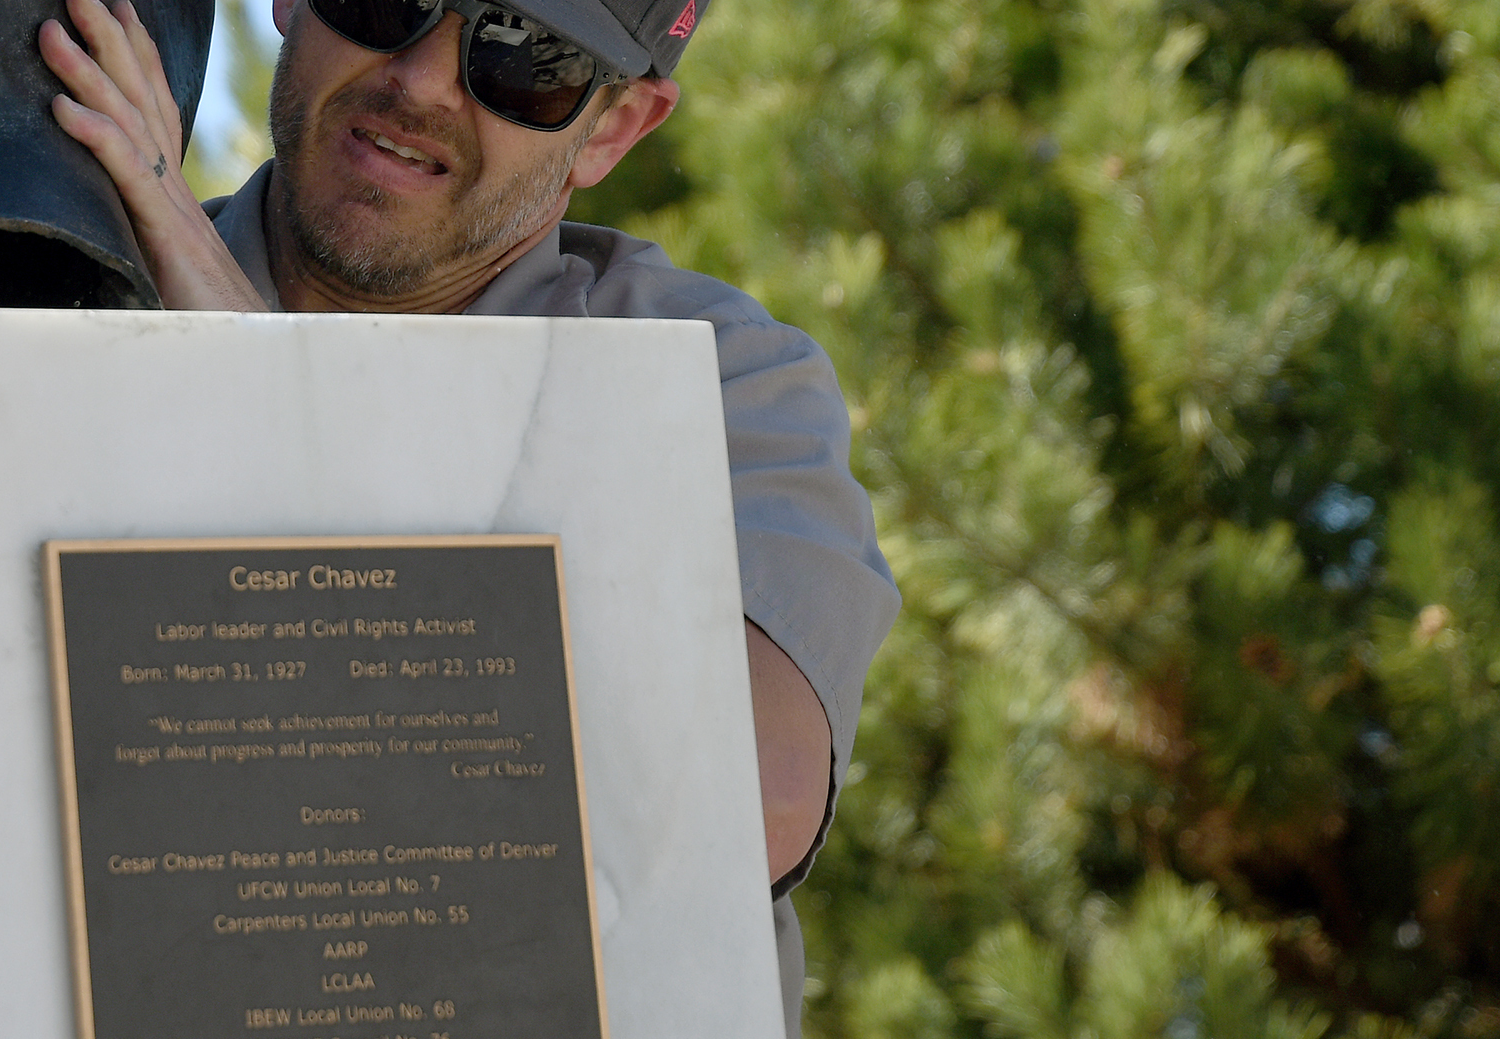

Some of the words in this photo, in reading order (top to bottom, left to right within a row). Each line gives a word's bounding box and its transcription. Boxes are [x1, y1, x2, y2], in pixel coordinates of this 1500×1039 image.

[229, 565, 300, 591] Cesar
[308, 564, 398, 590] Chavez
[155, 621, 206, 641] Labor
[212, 621, 266, 640] leader
[273, 619, 305, 639] and
[311, 618, 348, 638] Civil
[354, 617, 408, 640] Rights
[413, 616, 476, 636] Activist
[120, 664, 168, 684] Born:
[173, 663, 225, 682] March
[231, 662, 258, 682] 31,
[265, 661, 306, 680] 1927
[350, 660, 393, 678] Died:
[399, 659, 437, 679] April
[442, 658, 469, 677] 23,
[475, 657, 516, 676] 1993
[186, 717, 237, 734] cannot
[242, 713, 274, 732] seek
[278, 713, 370, 731] achievement
[374, 710, 396, 728] for
[401, 710, 468, 728] ourselves
[472, 708, 499, 726] and
[164, 742, 207, 760] about
[210, 742, 275, 764] progress
[278, 738, 306, 758] and
[309, 736, 382, 759] prosperity
[387, 736, 410, 754] for
[412, 739, 438, 755] our
[450, 761, 490, 779] Cesar
[494, 759, 546, 777] Chavez
[300, 806, 366, 826] Donors:
[108, 854, 157, 874] Cesar
[162, 852, 225, 873] Chavez
[230, 850, 280, 869] Peace
[284, 848, 317, 867] and
[323, 846, 379, 866] Justice
[383, 844, 474, 864] Committee
[478, 841, 495, 860] of
[500, 841, 558, 860] Denver
[236, 880, 288, 901] UFCW
[294, 879, 343, 899] Union
[347, 877, 391, 897] Local
[395, 876, 424, 895] No.
[430, 874, 441, 892] 7
[213, 913, 308, 935] Carpenters
[312, 911, 356, 930] Local
[360, 909, 409, 928] Union
[414, 906, 442, 925] No.
[448, 905, 470, 925] 55
[323, 941, 368, 959] AARP
[321, 972, 376, 993] LCLAA
[245, 1008, 292, 1029] IBEW
[297, 1006, 341, 1027] Local
[345, 1005, 394, 1024] Union
[399, 1002, 428, 1021] No.
[433, 999, 456, 1020] 68
